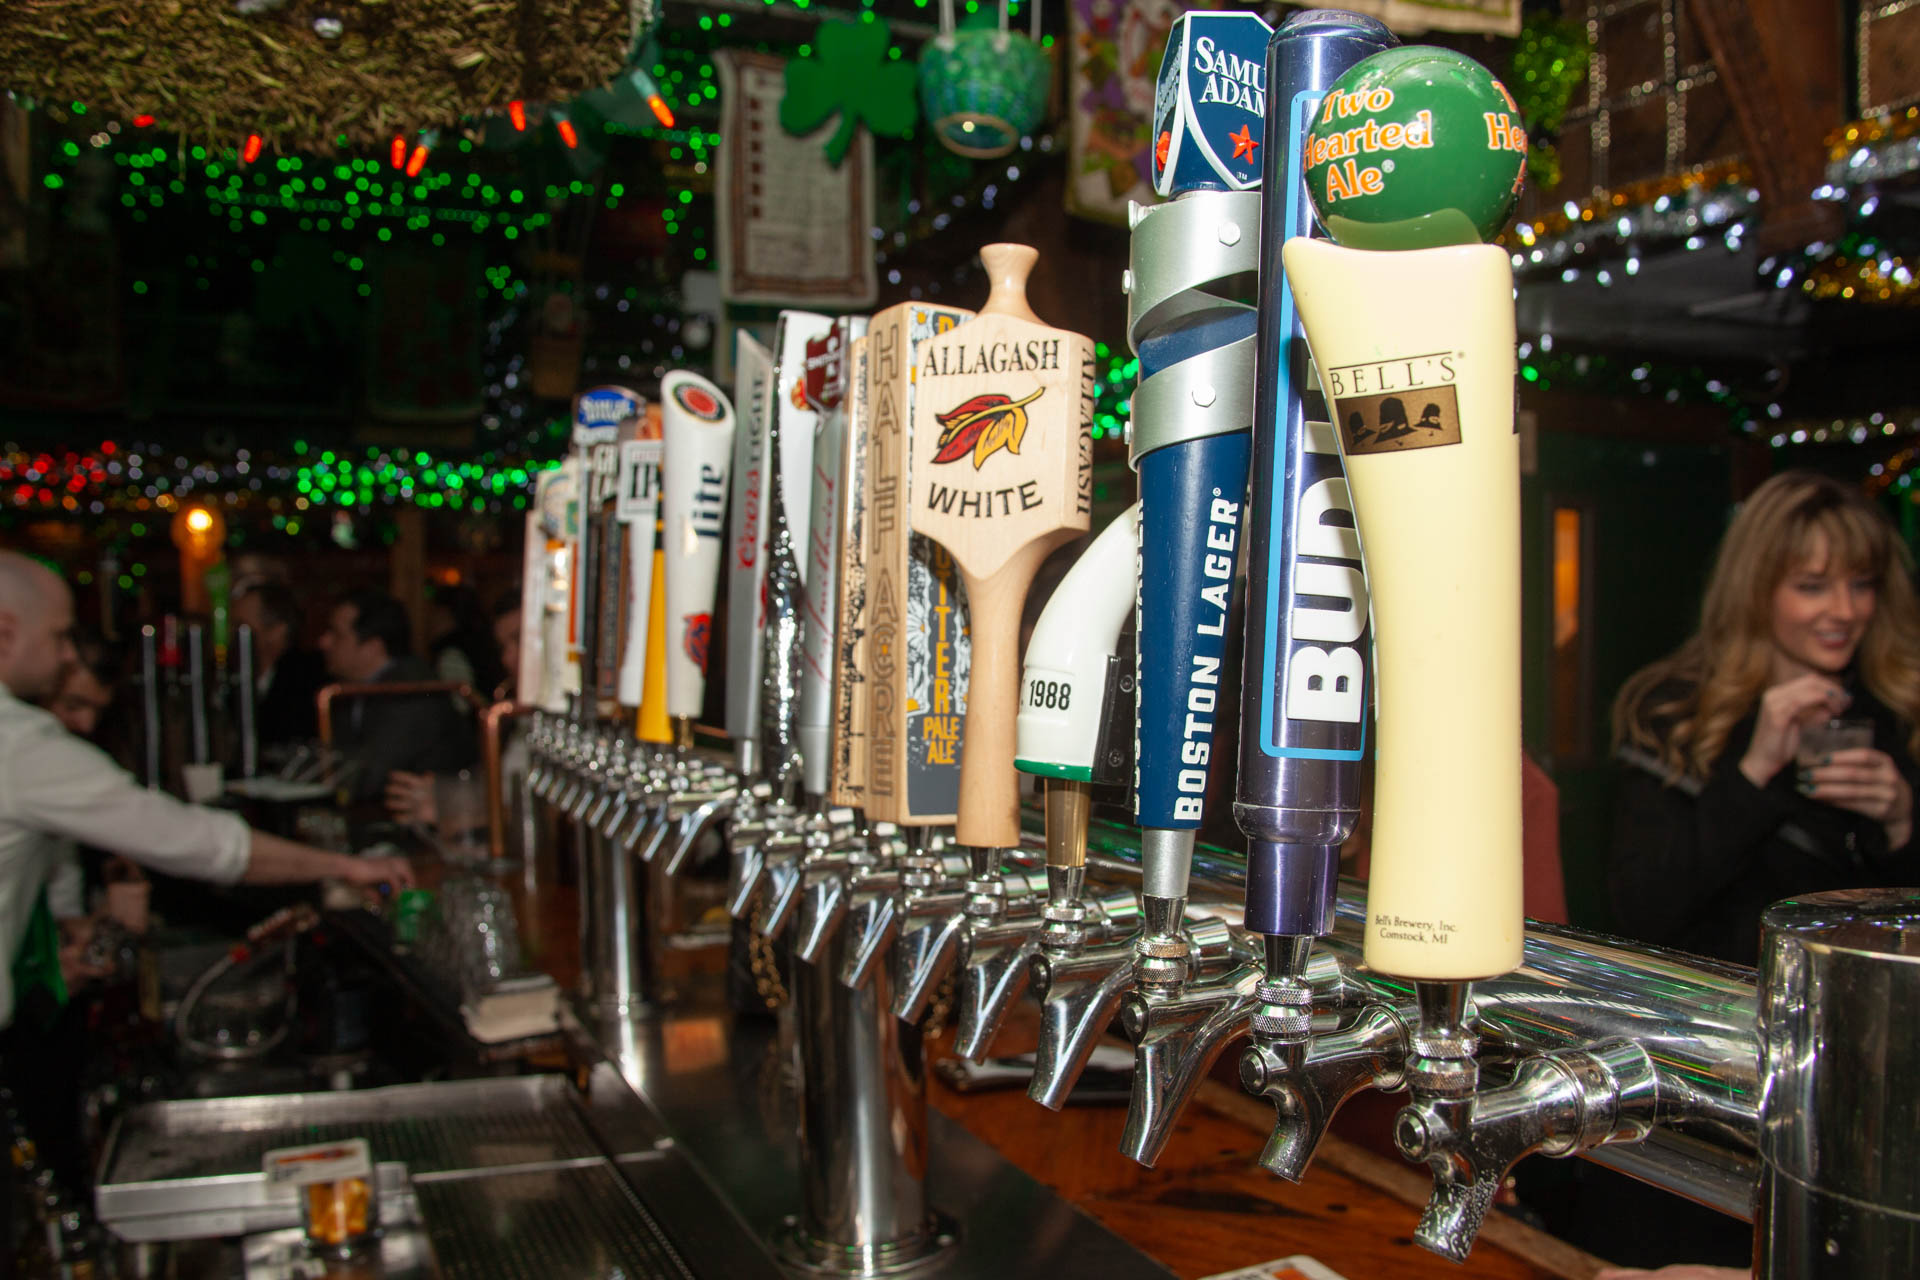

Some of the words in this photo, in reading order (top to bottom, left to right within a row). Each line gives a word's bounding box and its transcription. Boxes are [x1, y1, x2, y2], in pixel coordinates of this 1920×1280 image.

[1194, 36, 1266, 93] SAMU
[1321, 86, 1395, 124] Two
[1303, 109, 1434, 172] Hearted
[1326, 158, 1384, 203] Ale
[922, 338, 1061, 377] ALLAGASH
[1330, 354, 1457, 397] BELL'S
[872, 323, 899, 555] HALF
[927, 480, 1044, 519] WHITE
[1287, 476, 1370, 723] BUD
[933, 542, 951, 714] UTTER
[1174, 655, 1220, 821] BOSTON
[1197, 497, 1239, 637] LAGER
[1028, 679, 1072, 711] 1988
[923, 715, 960, 741] PALE
[926, 740, 956, 764] ALE
[1375, 914, 1392, 926] Bell's
[1394, 917, 1435, 932] Brewery,
[1379, 927, 1428, 944] Comstock,
[1431, 934, 1449, 945] MI
